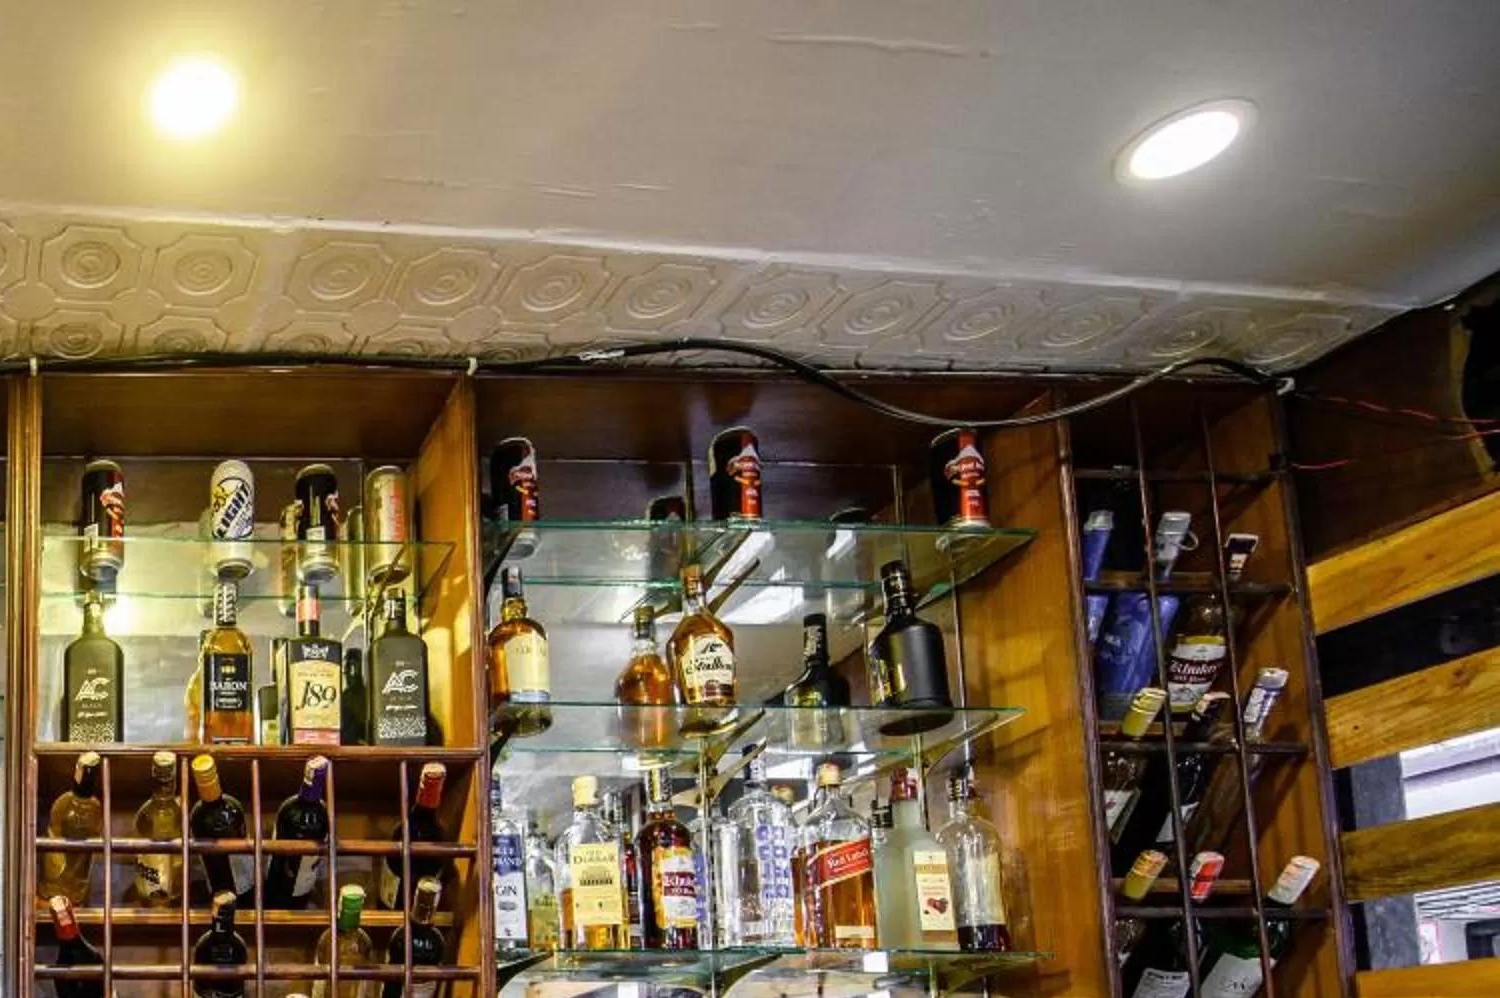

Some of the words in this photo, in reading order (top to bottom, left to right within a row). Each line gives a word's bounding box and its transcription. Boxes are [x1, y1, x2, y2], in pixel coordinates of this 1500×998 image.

[75, 677, 111, 701] AC
[381, 670, 419, 695] AC
[295, 681, 336, 710] J89
[495, 884, 518, 897] GIN
